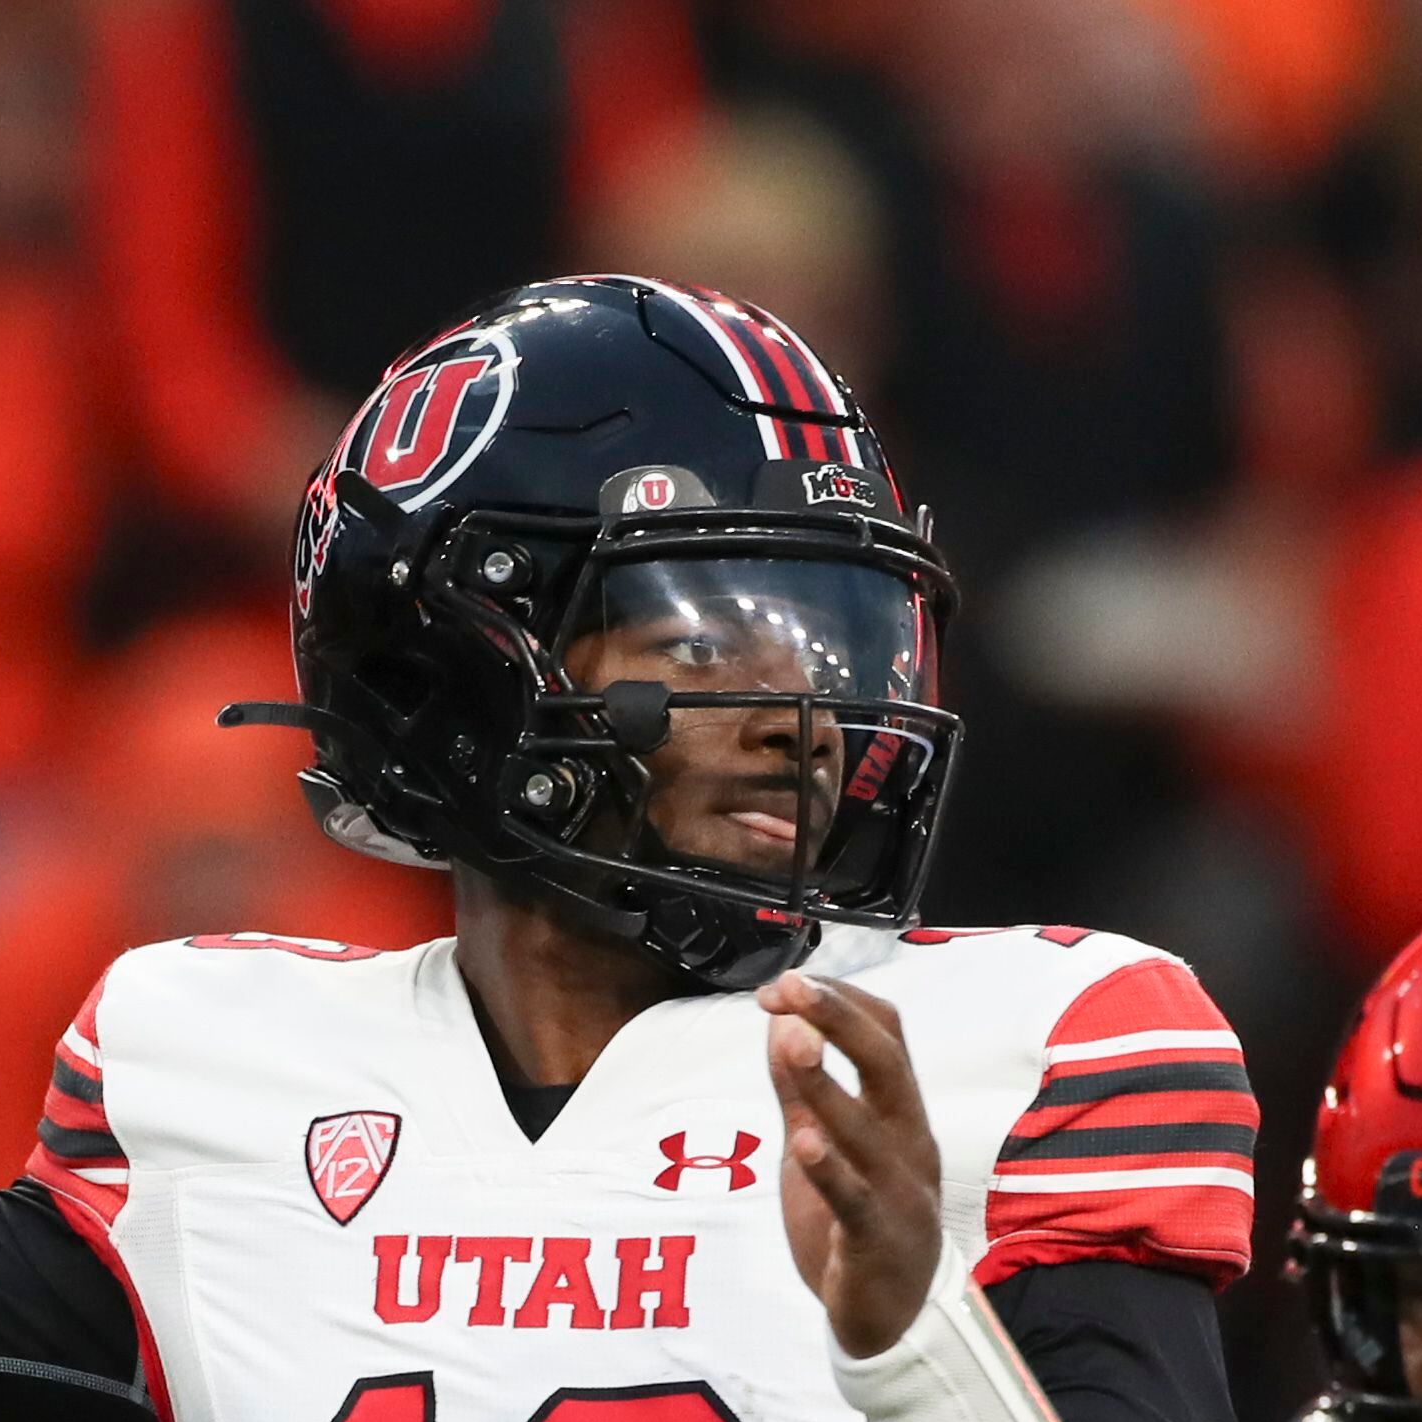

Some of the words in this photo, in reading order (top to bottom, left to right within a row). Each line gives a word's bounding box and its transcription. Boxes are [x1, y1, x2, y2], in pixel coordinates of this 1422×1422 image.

[360, 355, 496, 493] U
[642, 479, 668, 506] U
[309, 1114, 395, 1181] PAC
[325, 1157, 370, 1198] 12
[373, 1235, 696, 1330] UTAH
